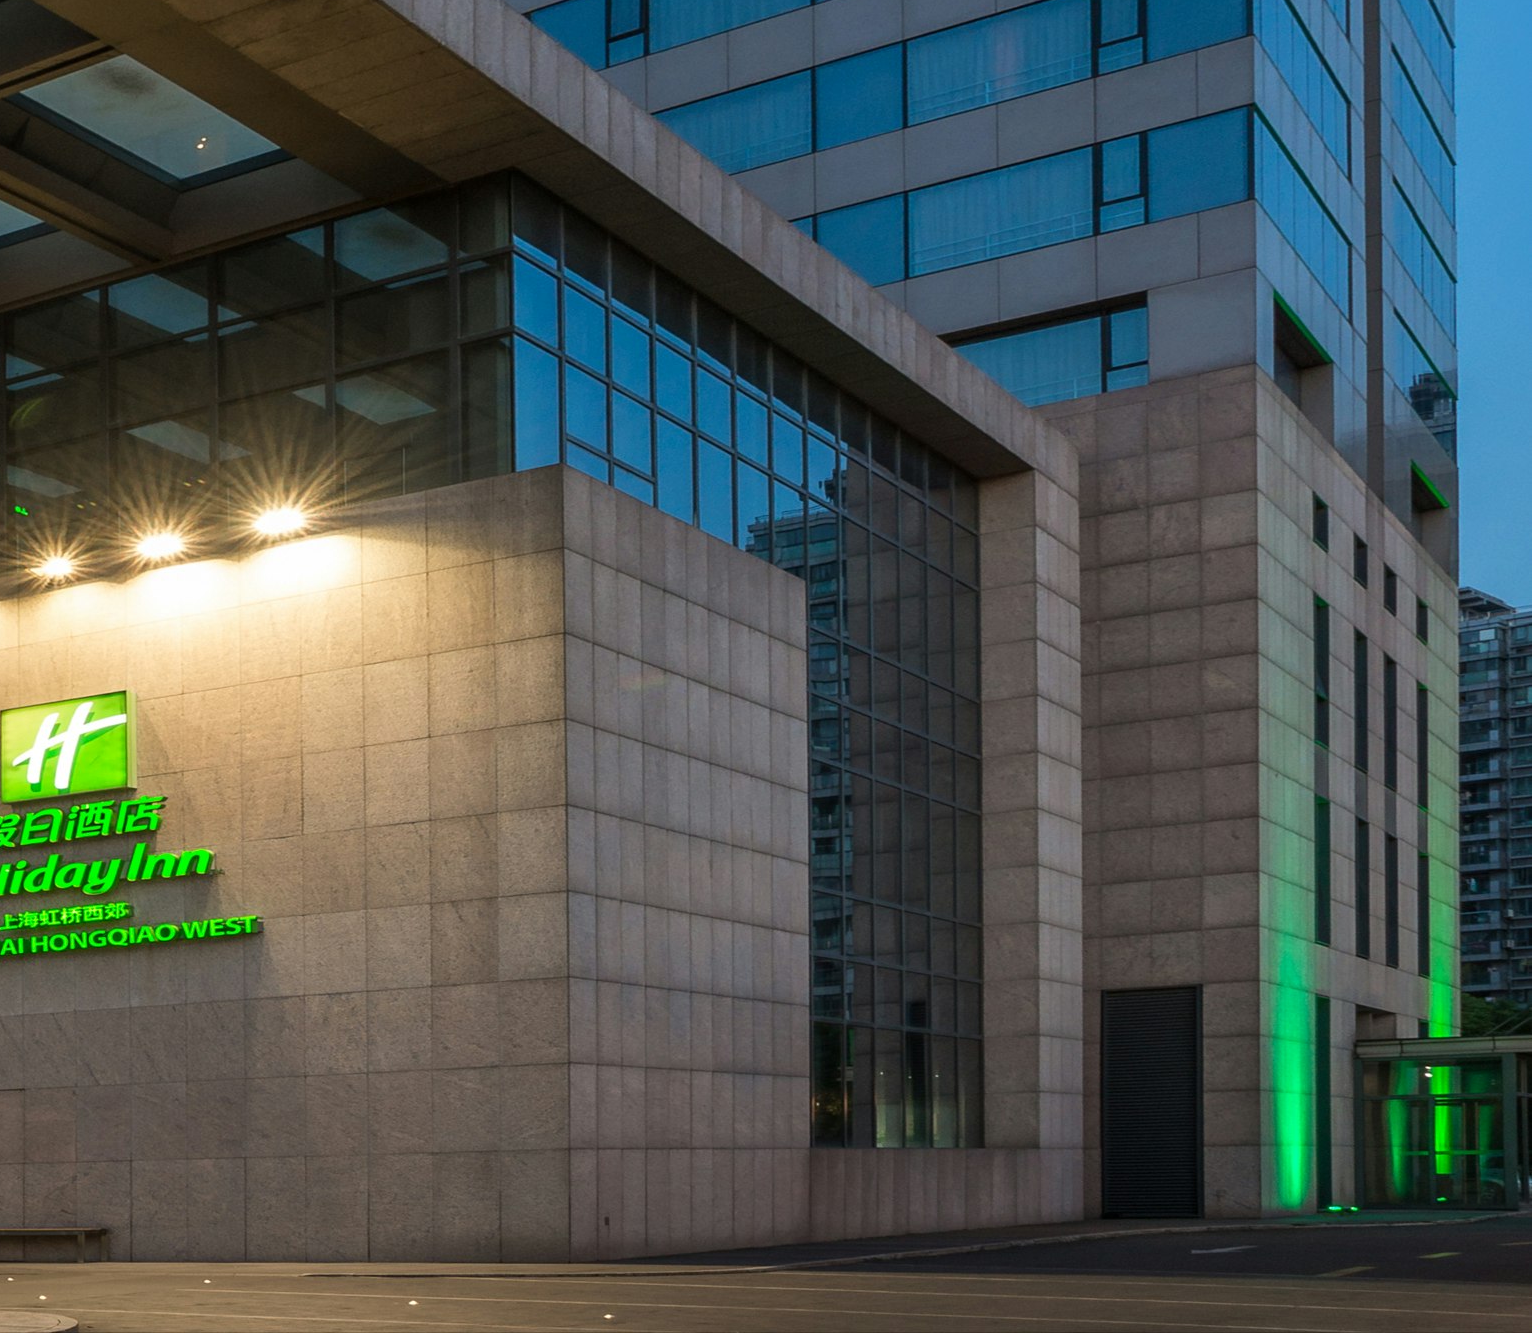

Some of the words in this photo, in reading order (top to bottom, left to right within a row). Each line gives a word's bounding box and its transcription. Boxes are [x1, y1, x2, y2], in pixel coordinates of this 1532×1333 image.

[127, 843, 213, 882] Inn
[30, 923, 178, 954] HONGQIAO
[181, 915, 258, 940] WEST
